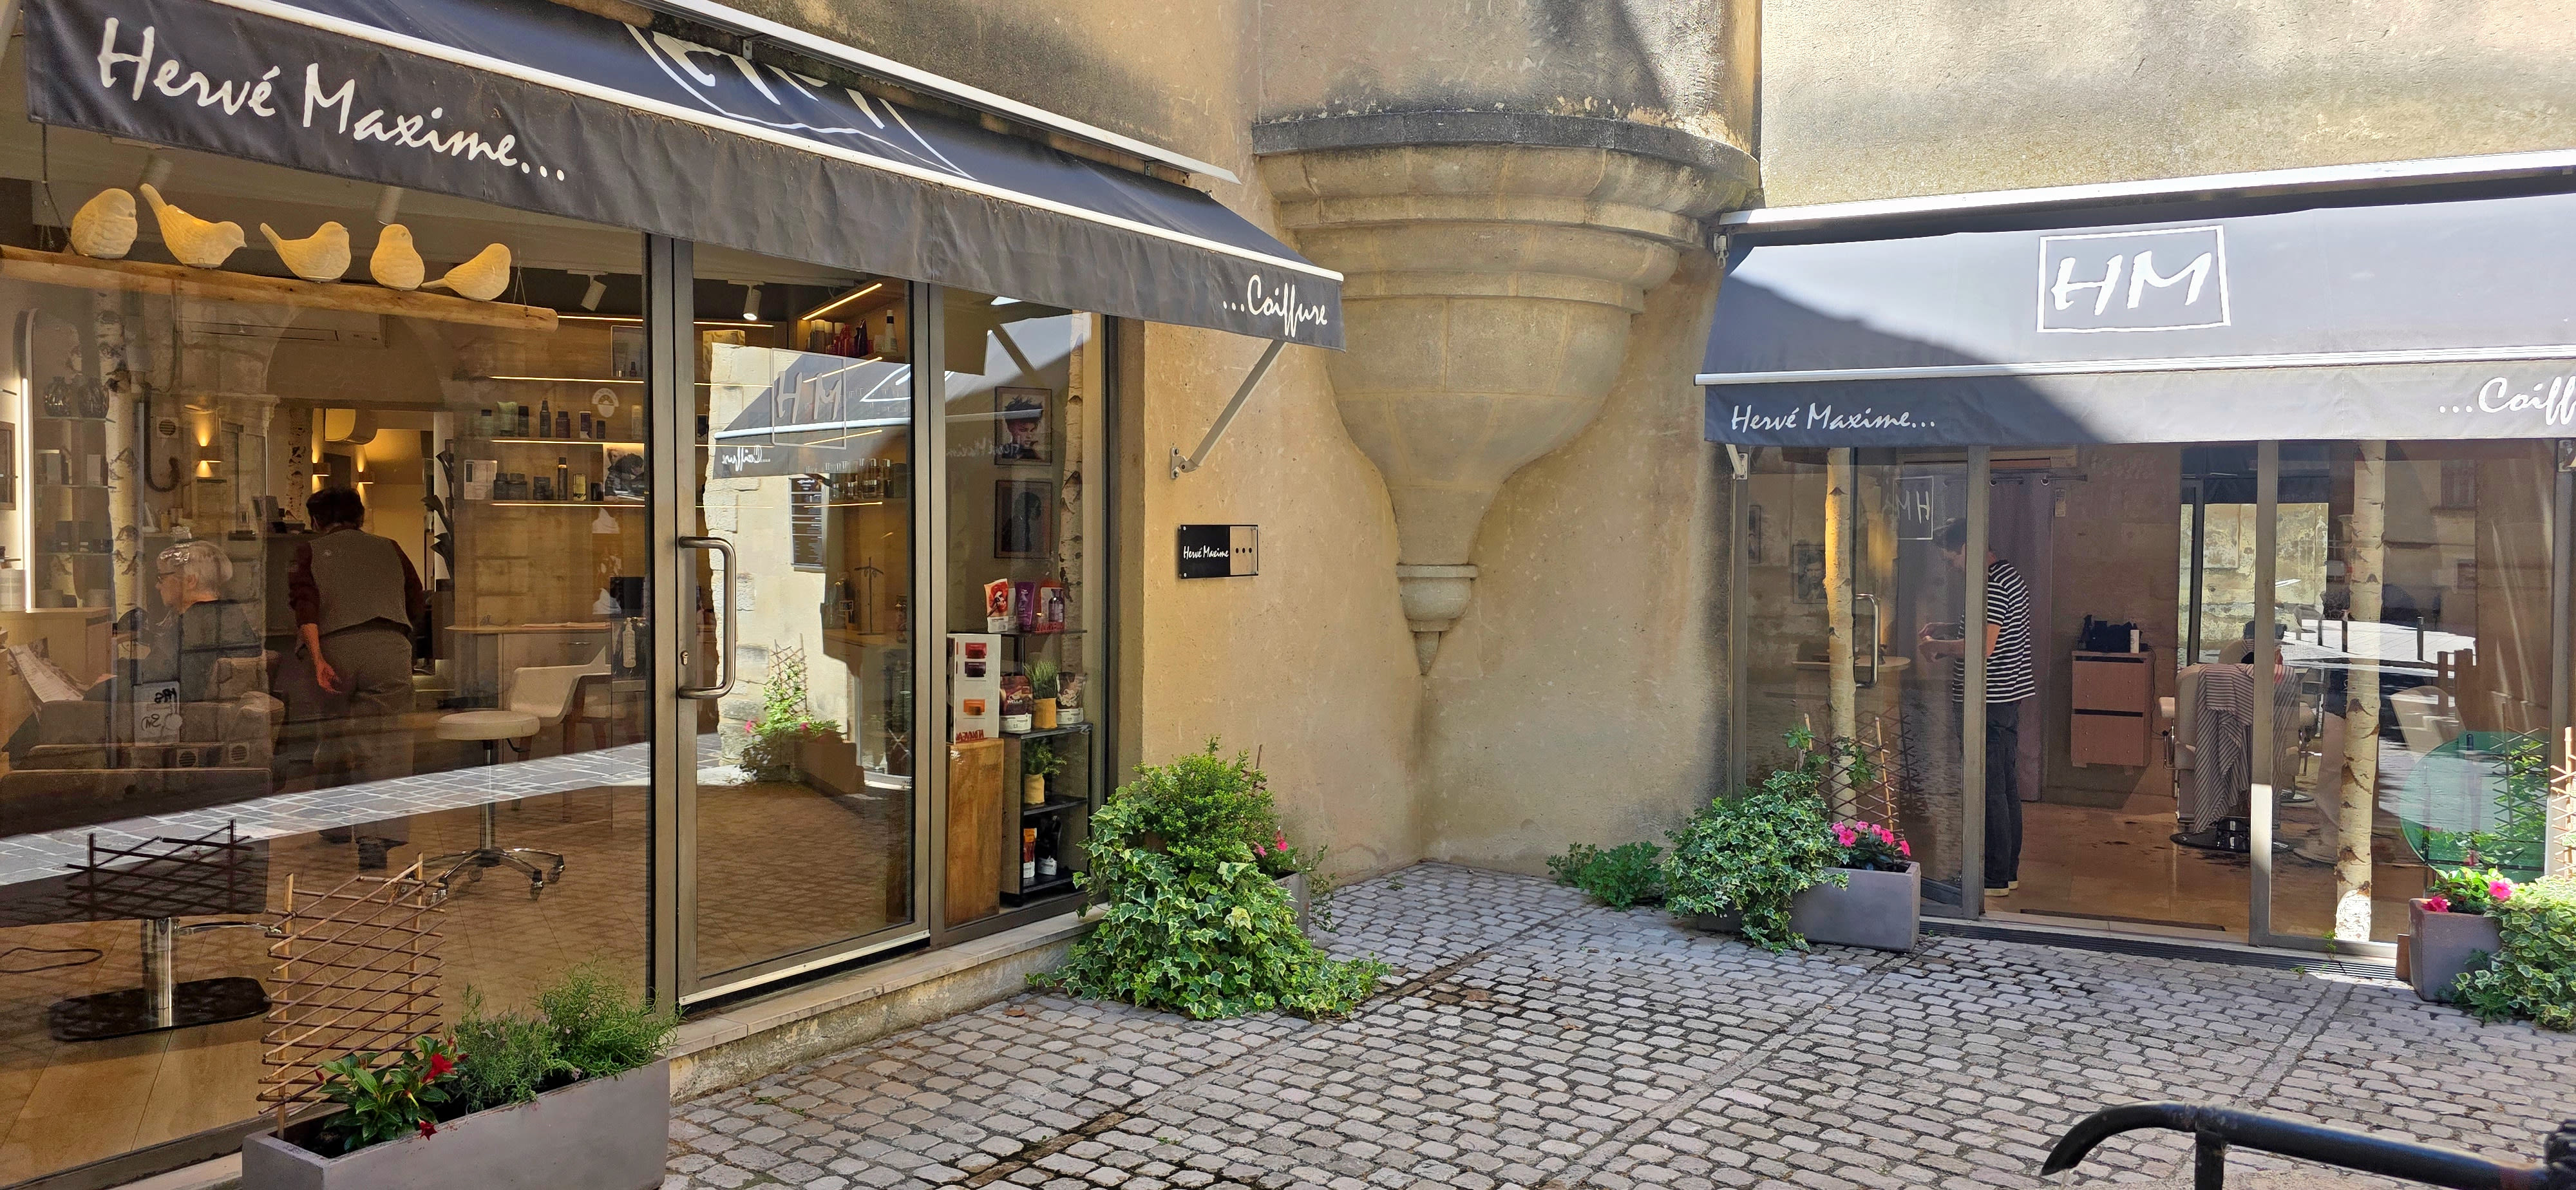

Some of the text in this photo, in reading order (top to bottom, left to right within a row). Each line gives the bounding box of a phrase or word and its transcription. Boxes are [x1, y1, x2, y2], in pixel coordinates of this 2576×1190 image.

[97, 17, 281, 117] Hervé
[1223, 275, 1328, 338] ...Coiffure
[2050, 250, 2212, 316] HM
[777, 370, 843, 424] HM
[1731, 404, 1799, 433] Hervé
[1183, 545, 1229, 560] Hervé Maxime
